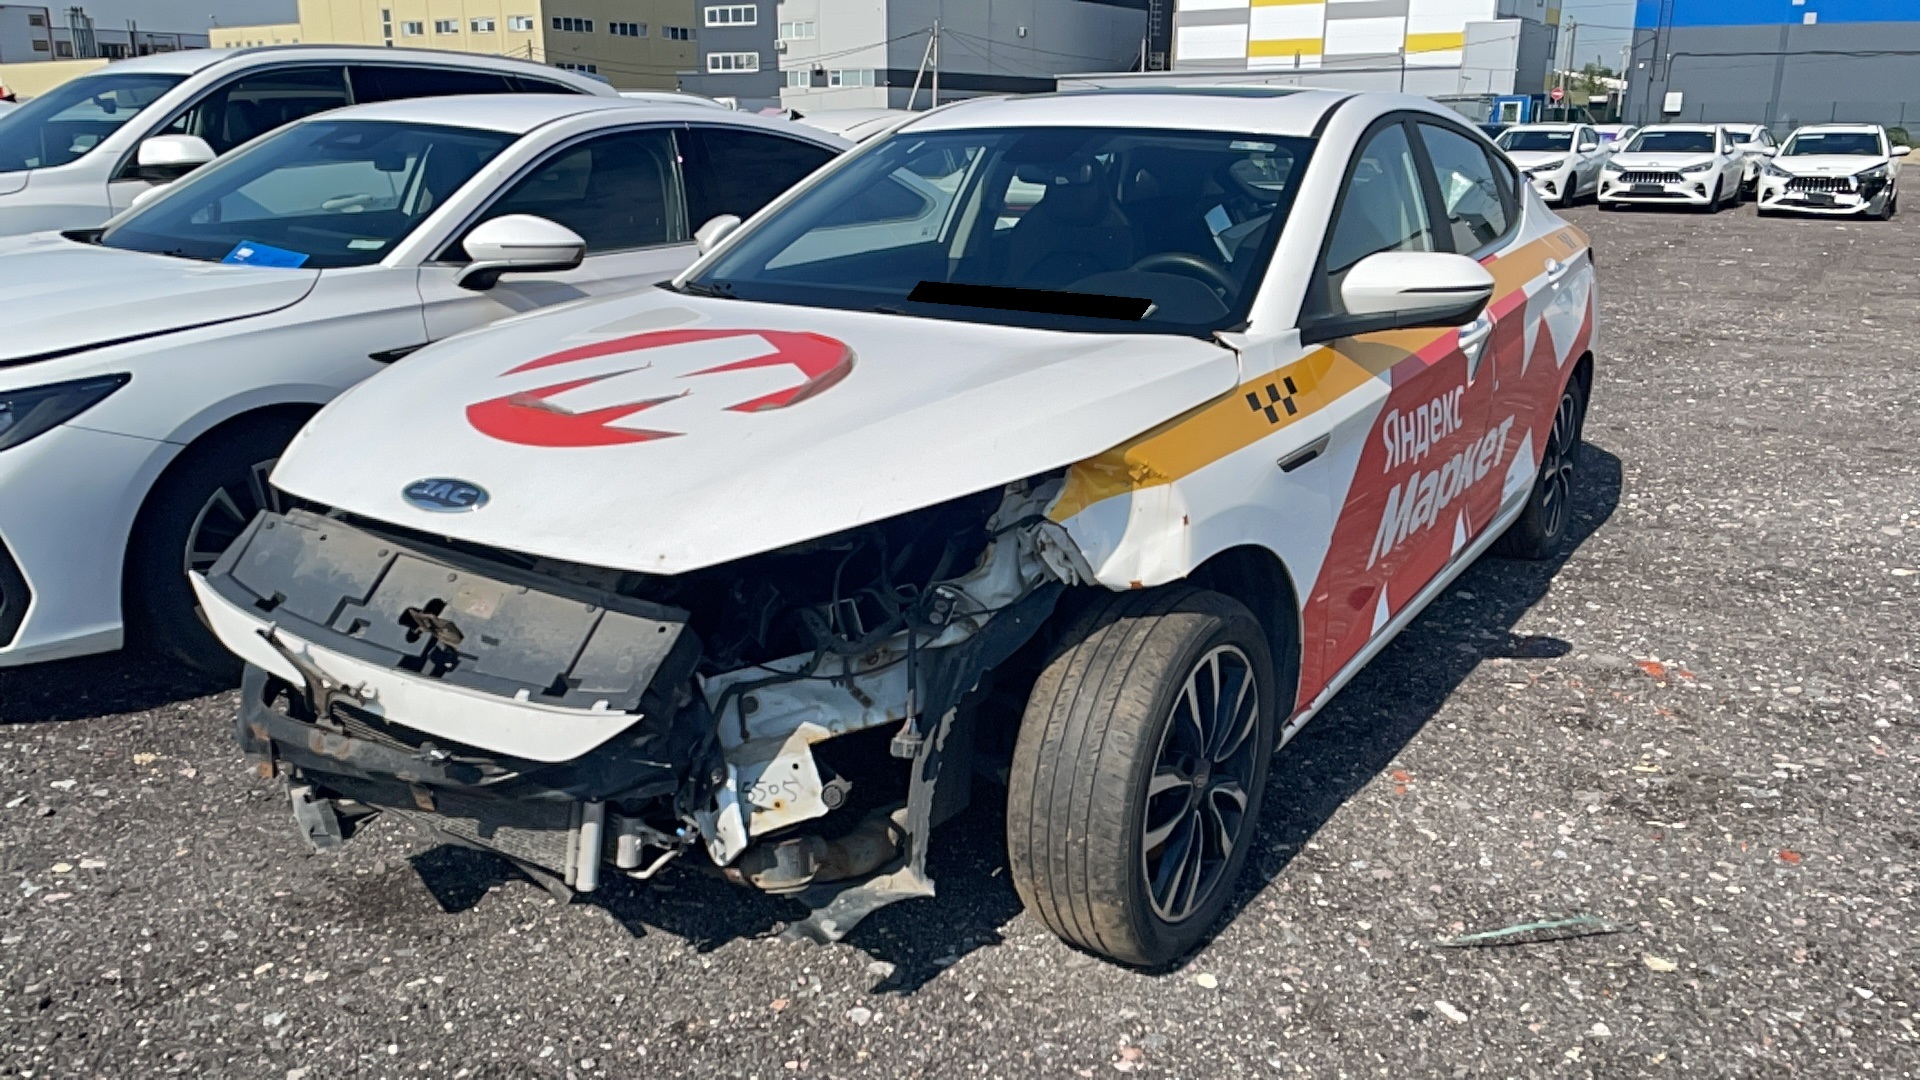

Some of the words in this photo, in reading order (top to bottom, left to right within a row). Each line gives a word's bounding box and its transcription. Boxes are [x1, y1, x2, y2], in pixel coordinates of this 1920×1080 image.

[1383, 385, 1464, 474] Яндекс
[410, 480, 478, 504] JAC
[1366, 414, 1515, 571] Маркет
